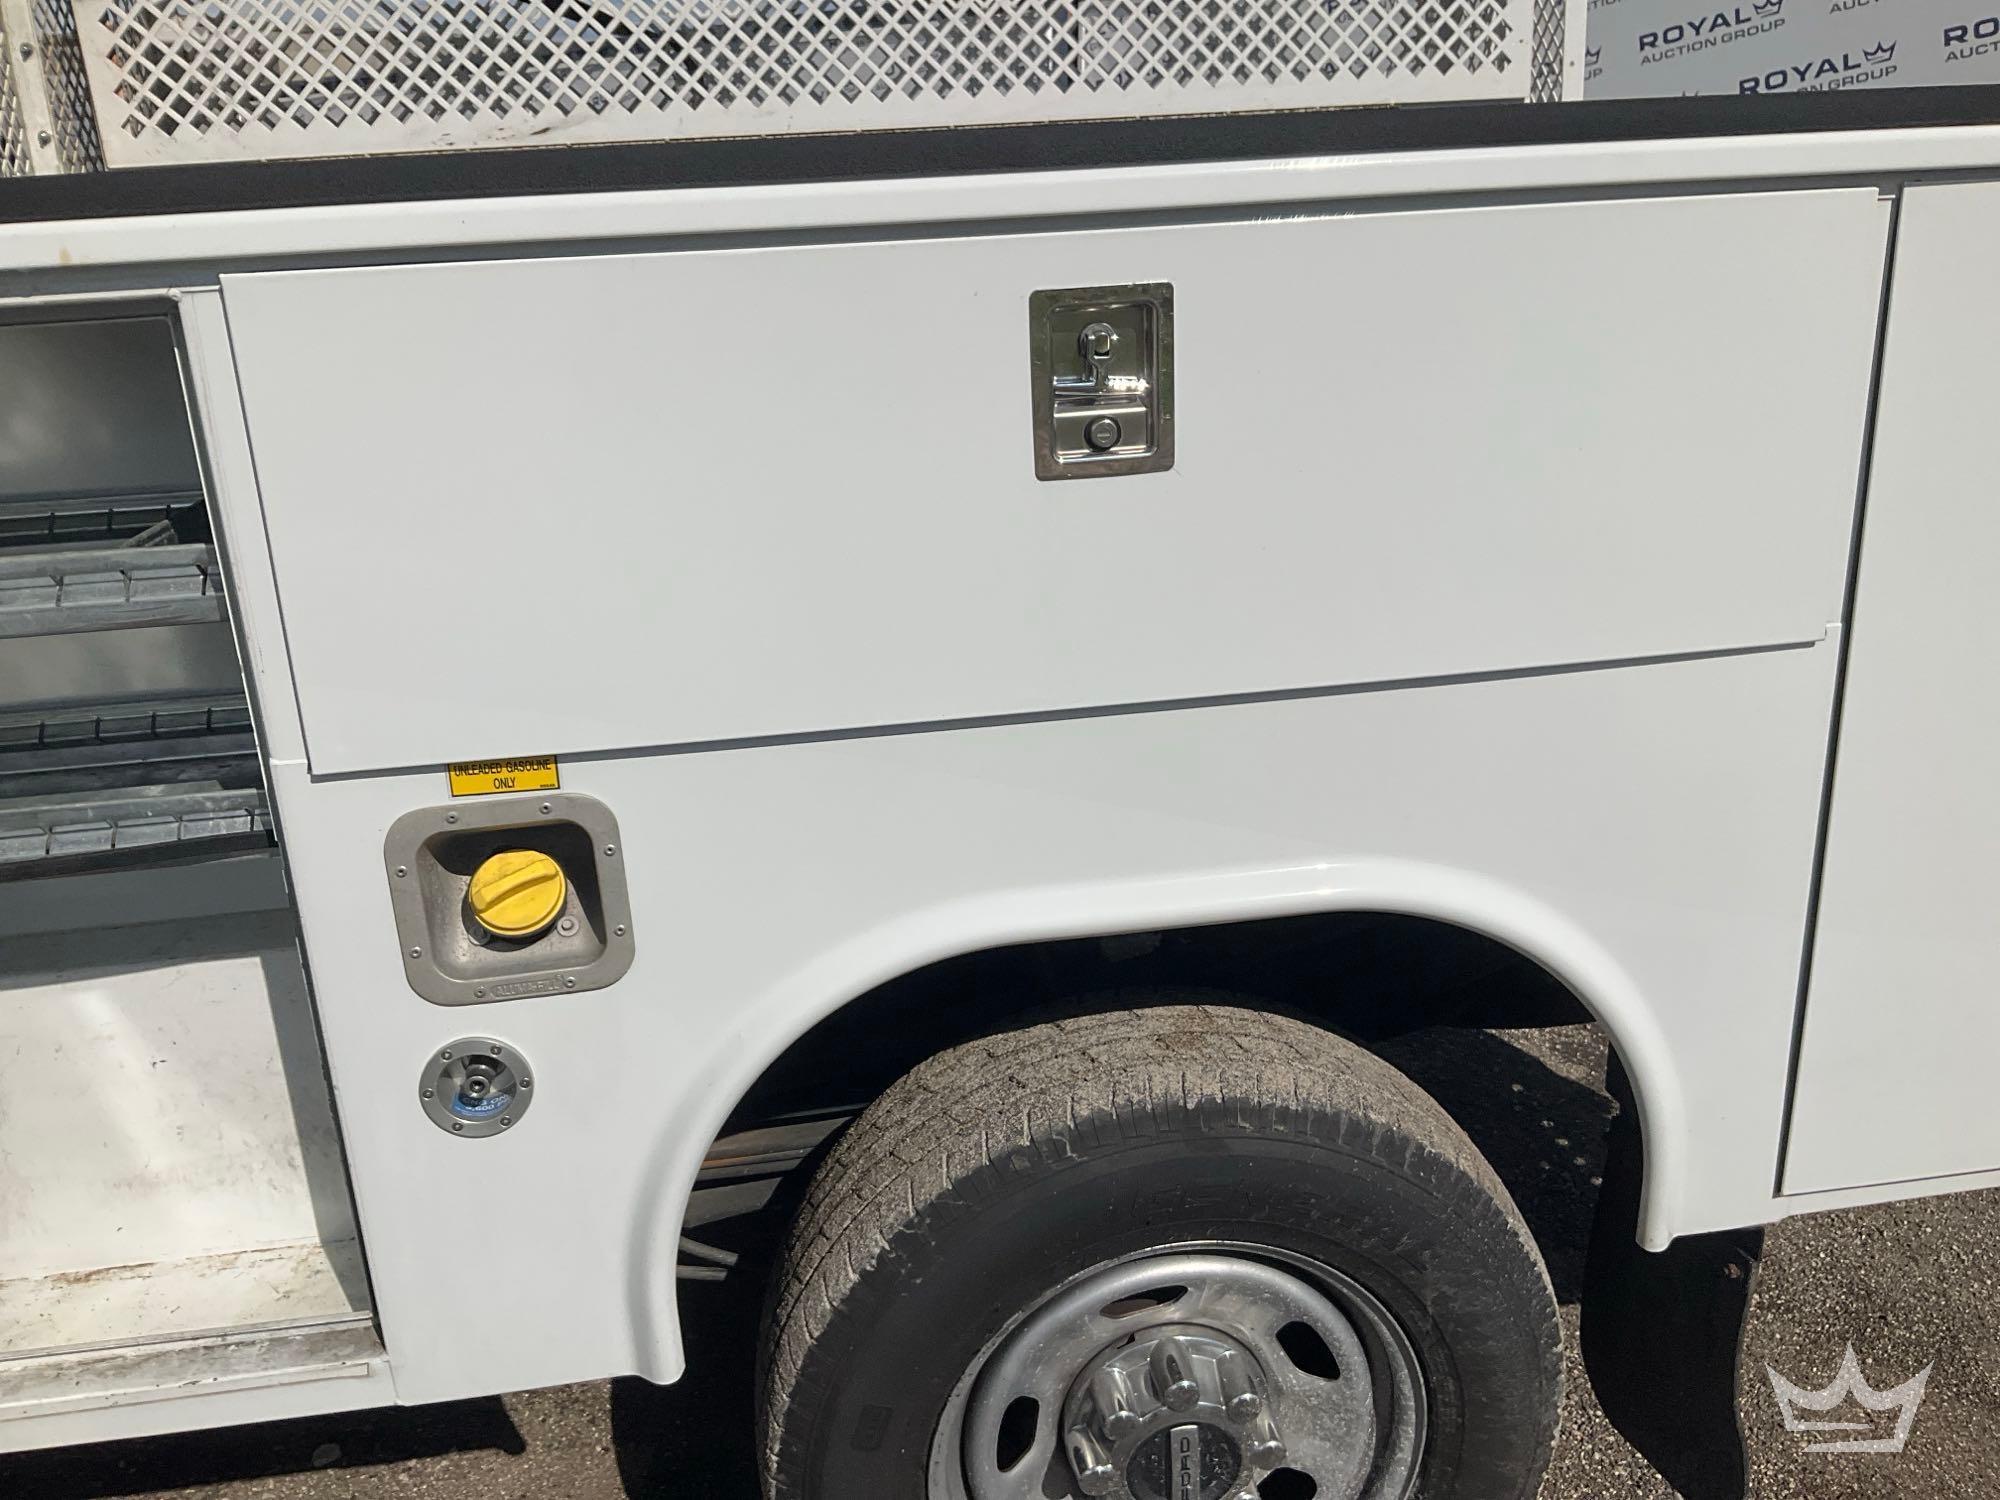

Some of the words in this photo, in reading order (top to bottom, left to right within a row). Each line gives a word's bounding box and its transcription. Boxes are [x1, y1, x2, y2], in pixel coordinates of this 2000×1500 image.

[1639, 8, 1752, 51] ROYAL
[1641, 36, 1718, 66] AUCTION
[1721, 18, 1785, 43] GROUP
[1944, 17, 2000, 47] RO
[1739, 53, 1862, 96] ROYAL
[1828, 65, 1898, 91] GROUP
[454, 763, 502, 777] UNLEADED
[506, 759, 551, 773] GASOLINE
[493, 778, 516, 789] ONLY
